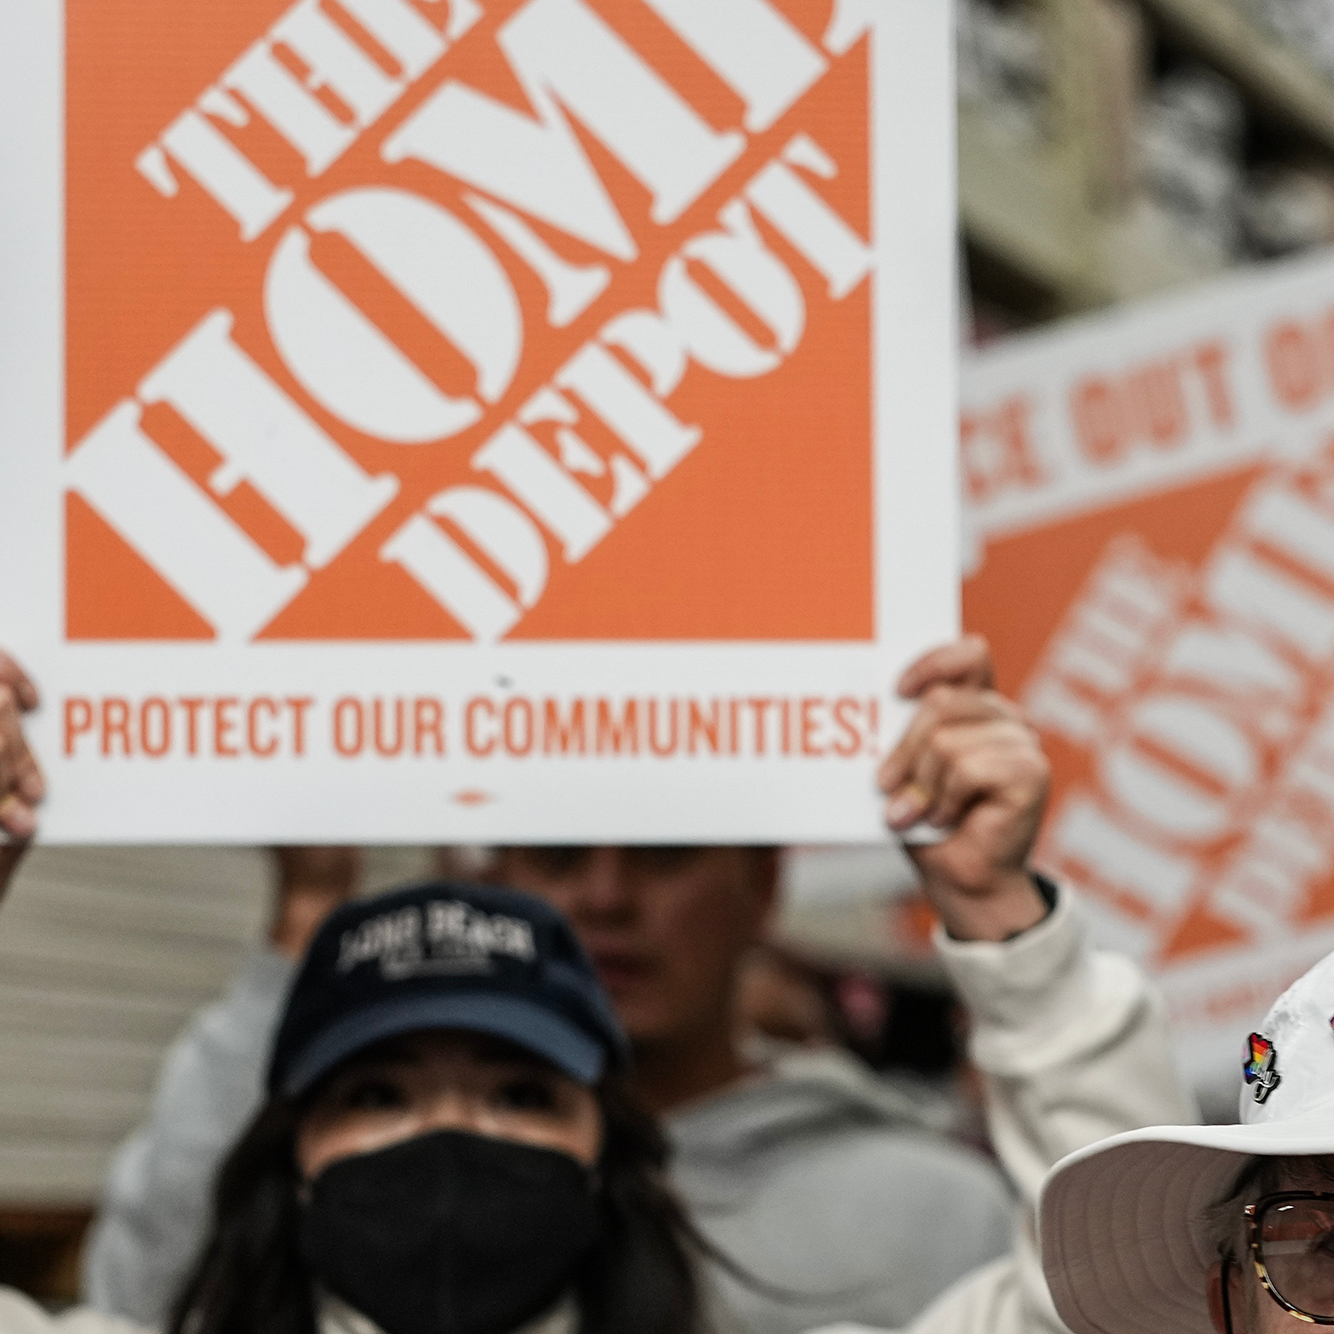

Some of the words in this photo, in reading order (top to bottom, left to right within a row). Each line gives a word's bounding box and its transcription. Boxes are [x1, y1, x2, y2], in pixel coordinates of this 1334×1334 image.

[379, 134, 873, 642] DEPOT
[1069, 336, 1237, 467] OUT
[63, 696, 314, 758] PROTECT
[331, 696, 448, 758] OUR
[464, 696, 881, 758] COMMUNITIES!
